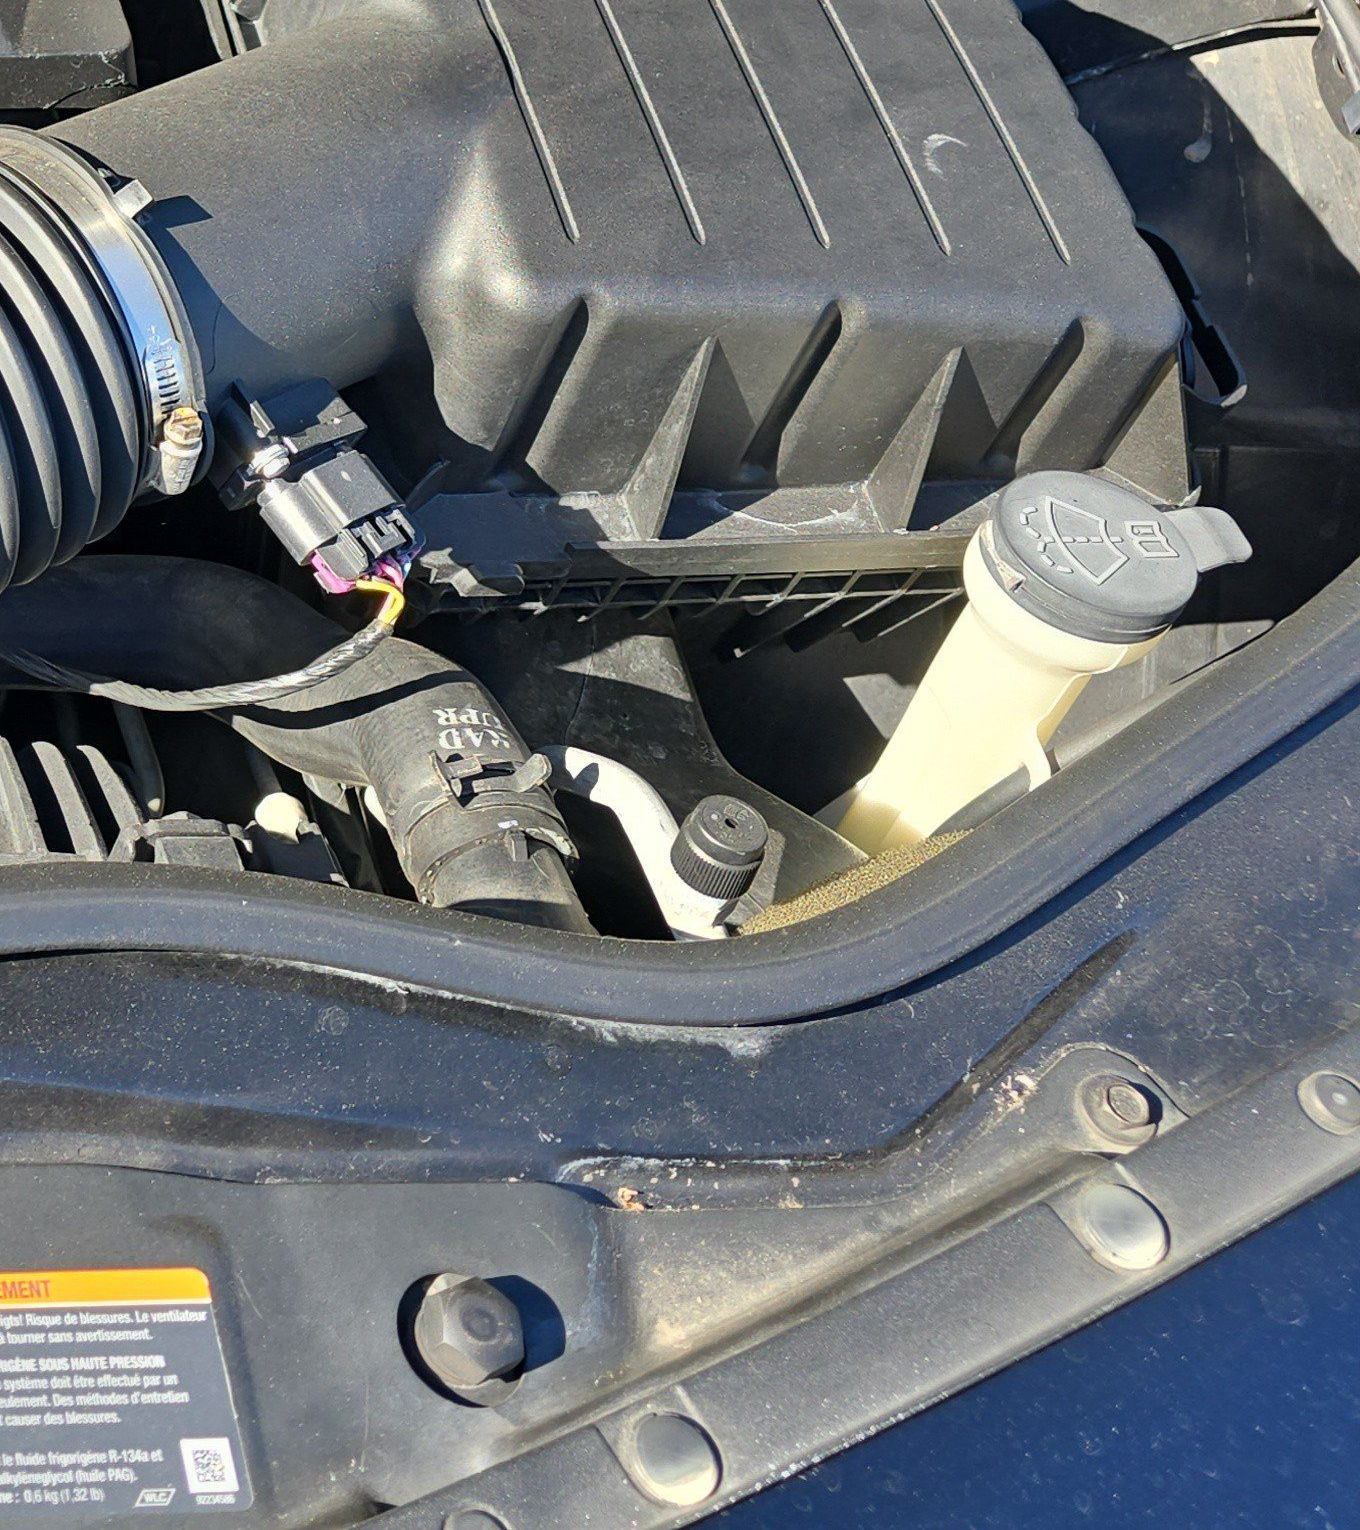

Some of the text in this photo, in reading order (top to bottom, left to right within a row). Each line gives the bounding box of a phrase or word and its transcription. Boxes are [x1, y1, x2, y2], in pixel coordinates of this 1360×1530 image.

[433, 707, 506, 732] UPR
[25, 1313, 62, 1327] Risque
[64, 1313, 78, 1324] de
[80, 1312, 133, 1325] blessures.
[135, 1311, 149, 1323] Le
[150, 1309, 207, 1322] ventilateur
[7, 1332, 45, 1344] tourner
[47, 1332, 73, 1343] sans
[76, 1328, 153, 1342] avertissement.
[38, 1357, 70, 1371] SOUS
[71, 1356, 108, 1370] HAUTE
[109, 1355, 166, 1369] PRESSION
[3, 1377, 48, 1392] système
[50, 1375, 71, 1389] doit
[73, 1374, 95, 1387] être
[97, 1373, 141, 1386] effectué
[143, 1375, 161, 1388] par
[163, 1374, 178, 1385] un
[52, 1394, 74, 1406] Des
[76, 1392, 129, 1405] méthodes
[4, 1414, 42, 1426] causer
[43, 1412, 64, 1424] des
[65, 1411, 122, 1424] blessures.
[3, 1453, 13, 1466] le
[15, 1452, 46, 1466] fluide
[48, 1450, 107, 1467] frigorigène
[108, 1449, 149, 1463] R-134a
[151, 1449, 164, 1461] et
[76, 1469, 107, 1483] (huile
[108, 1468, 138, 1483] PAG).
[44, 1489, 59, 1504] kg
[90, 1487, 105, 1501] lb)
